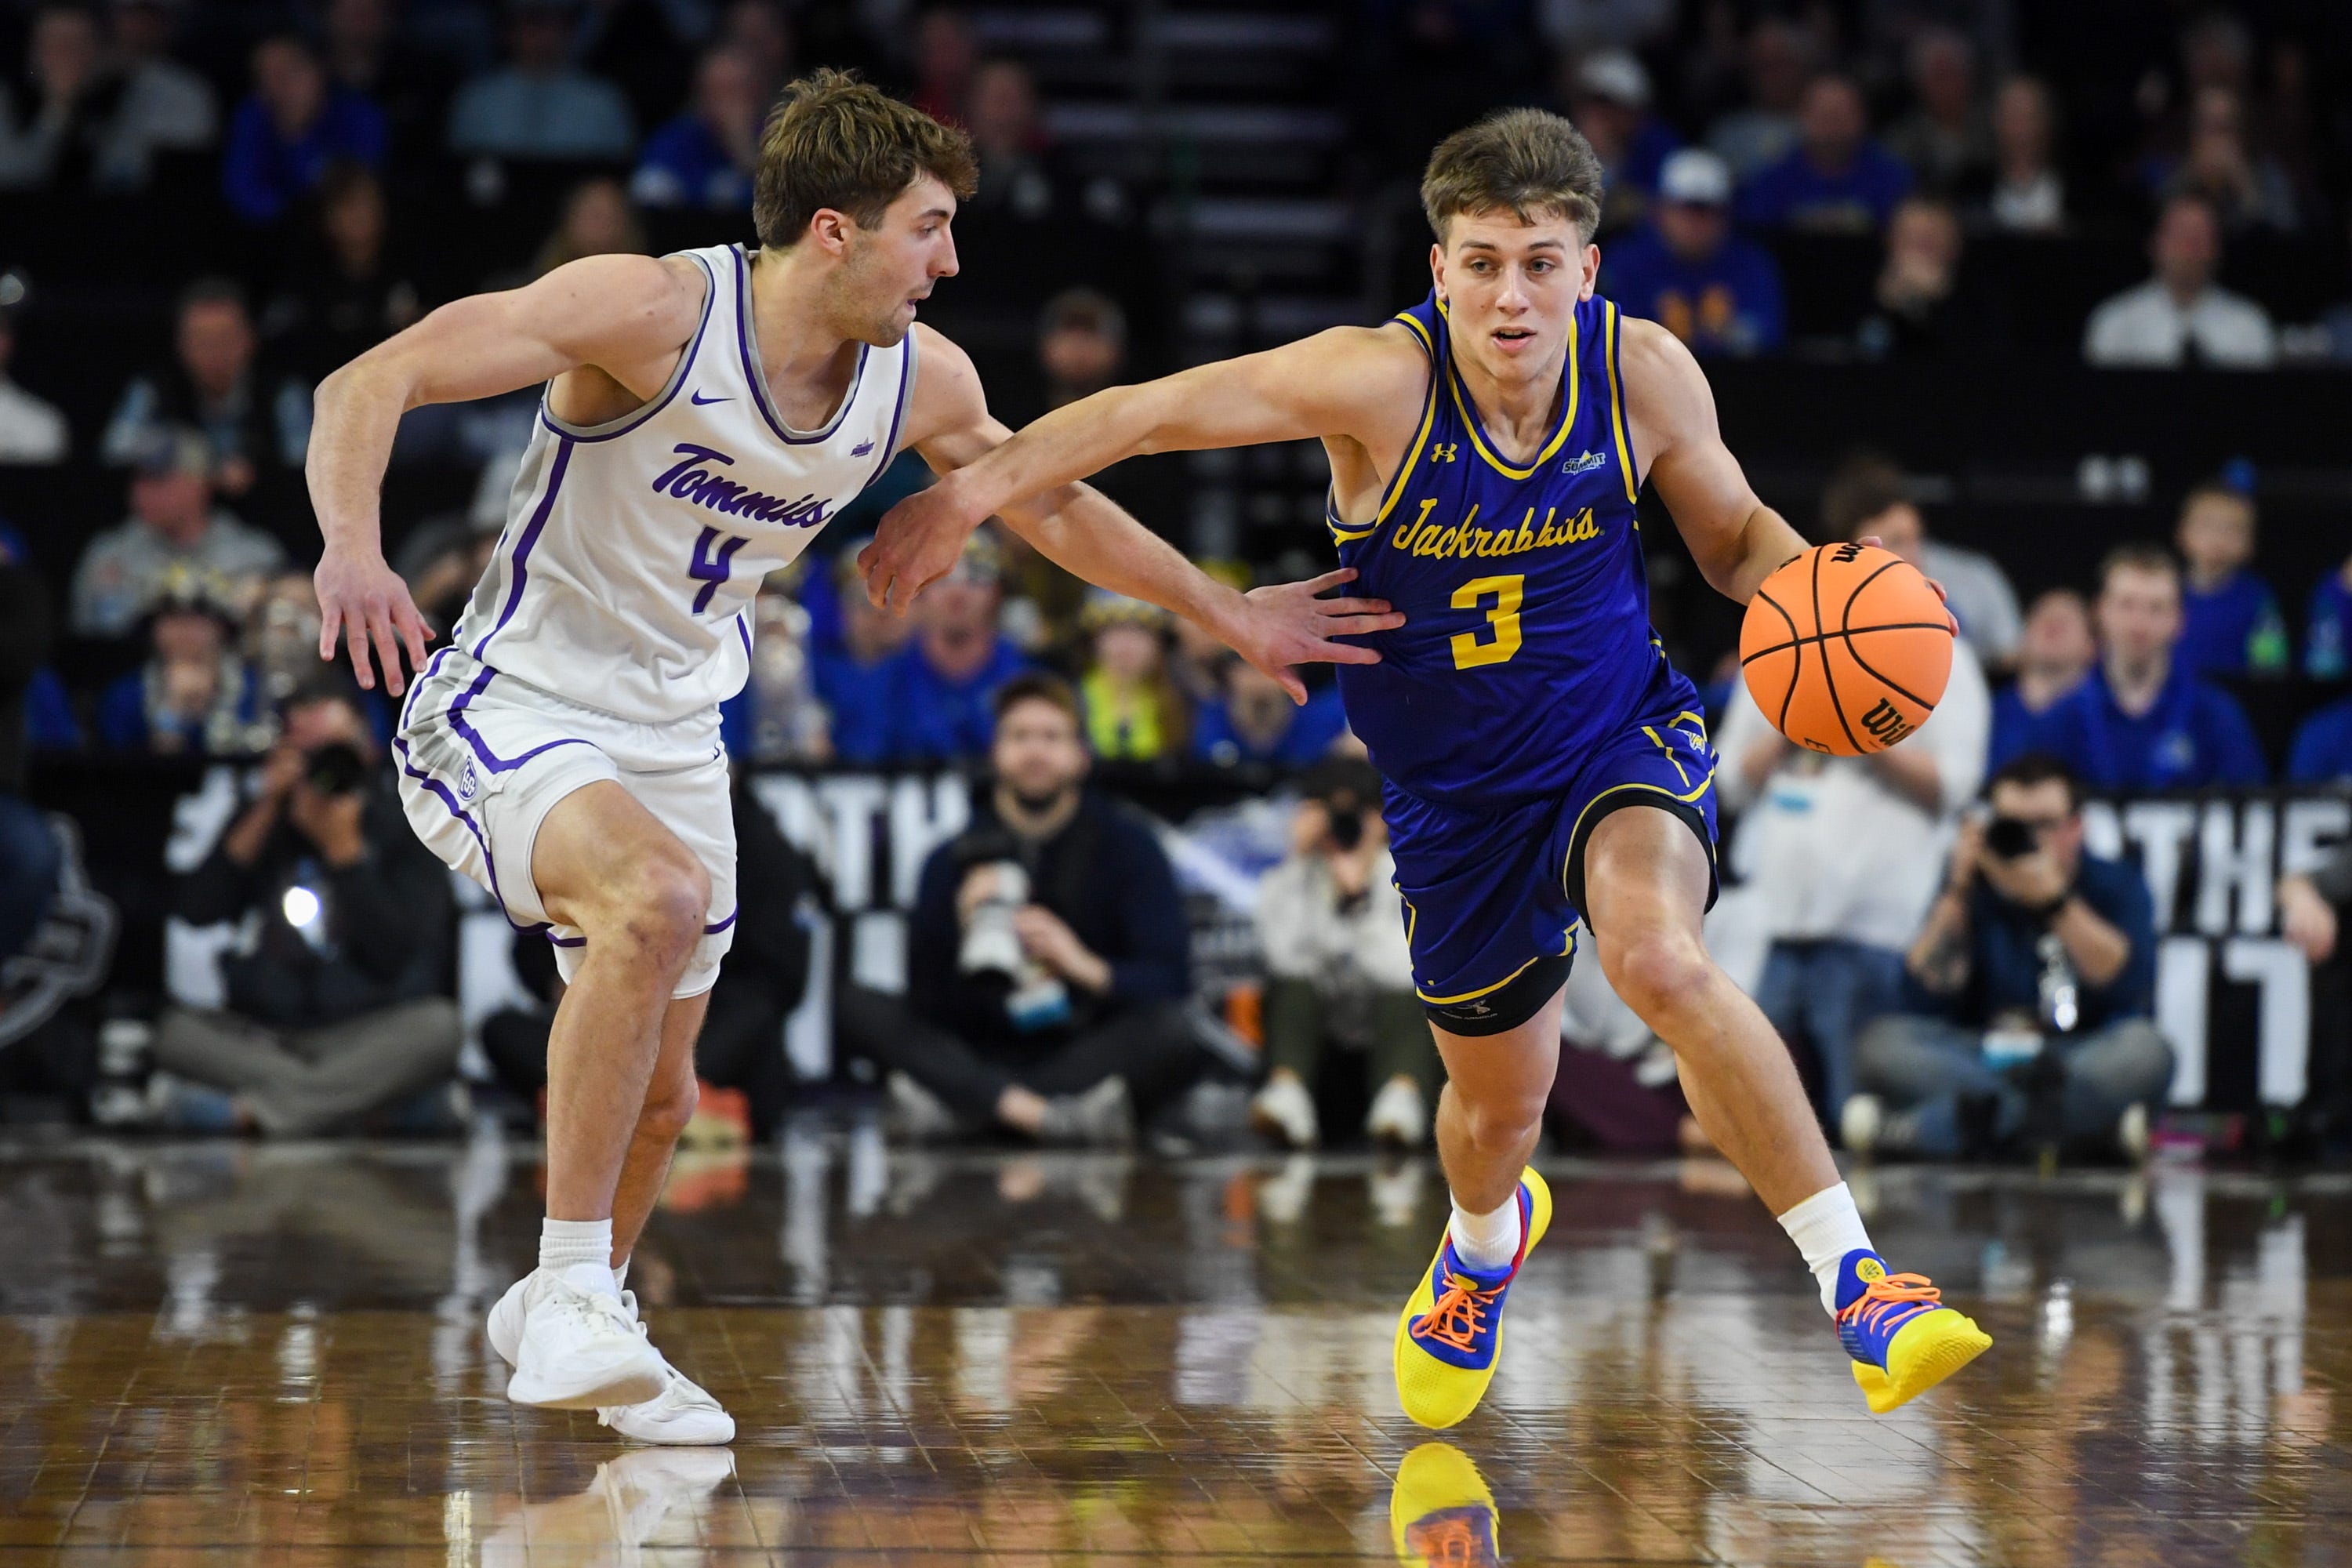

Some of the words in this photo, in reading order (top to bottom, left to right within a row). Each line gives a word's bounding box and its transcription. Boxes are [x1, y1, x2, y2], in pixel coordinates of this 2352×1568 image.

[652, 443, 834, 528] Tommies
[687, 524, 751, 617] 4
[1450, 574, 1525, 670] 3
[1861, 697, 1915, 747] Wil
